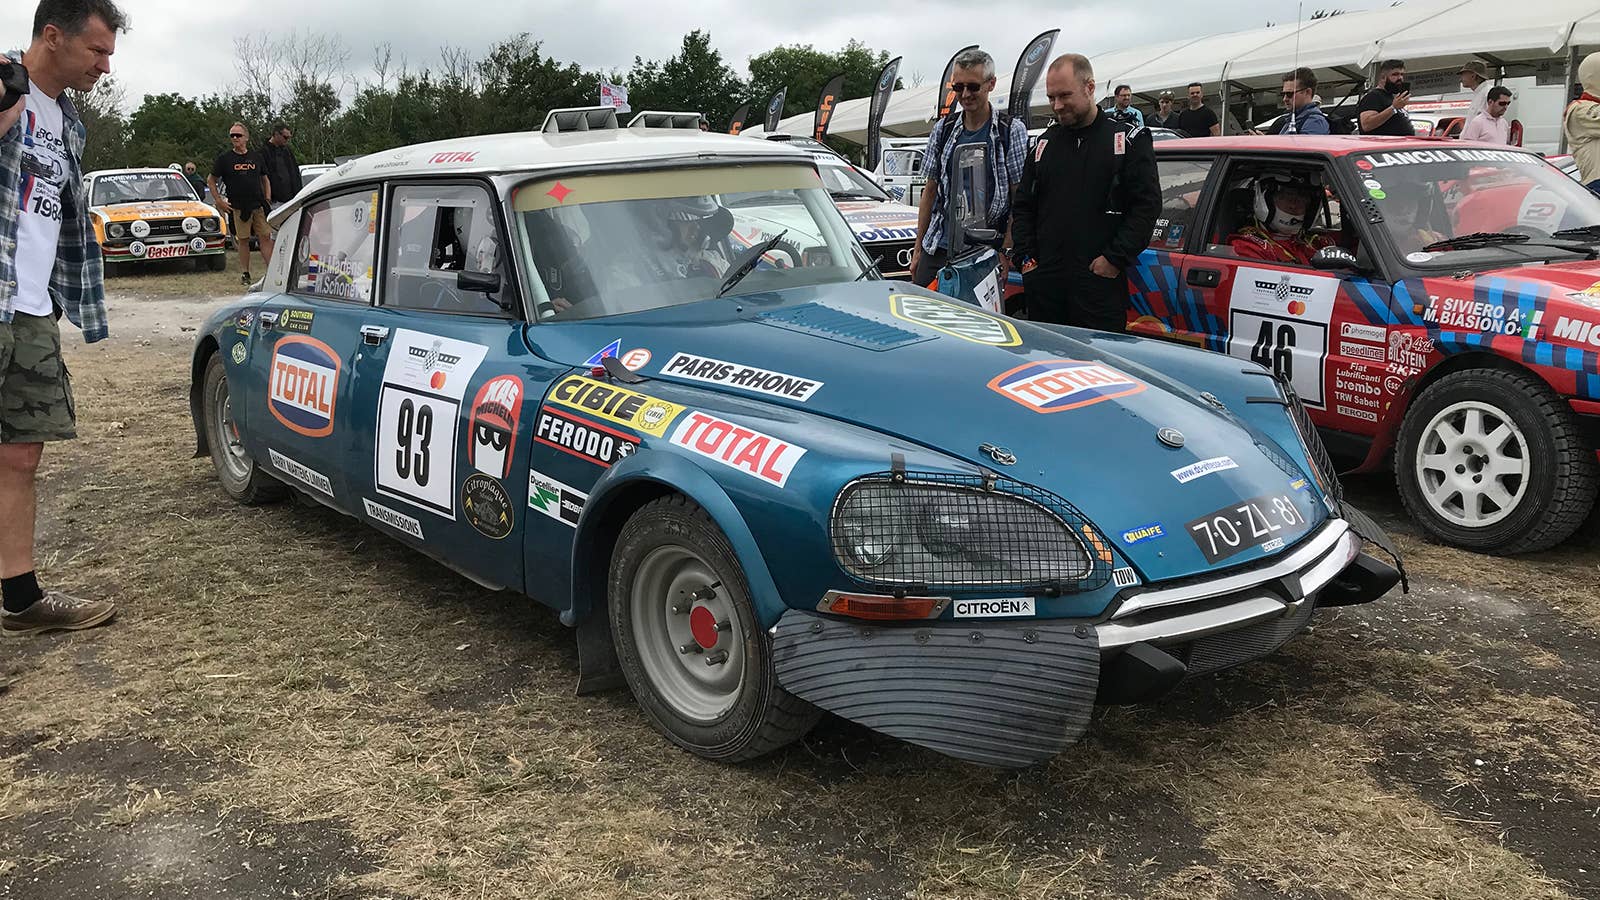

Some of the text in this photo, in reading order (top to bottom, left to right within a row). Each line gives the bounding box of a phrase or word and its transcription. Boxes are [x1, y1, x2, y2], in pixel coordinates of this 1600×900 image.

[234, 162, 256, 171] GCN
[428, 151, 479, 164] TOTAL
[1364, 149, 1538, 168] LANCIA MARTINI
[100, 174, 138, 184] ANDREWS
[354, 207, 364, 223] 93
[148, 244, 189, 259] Castrol
[1320, 246, 1357, 263] Valeo
[290, 310, 314, 320] SOUTHERN
[1429, 295, 1526, 322] T. SIVIERO A+
[1504, 321, 1522, 335] O+
[1251, 320, 1296, 379] 46
[1341, 345, 1384, 361] speedline
[1388, 346, 1427, 368] BILSTEIN
[629, 351, 645, 367] E
[1350, 362, 1367, 372] Fiat
[667, 355, 815, 398] PARIS-RHONE
[1336, 368, 1381, 383] Lubrificanti
[1386, 362, 1421, 376] SKF
[276, 361, 330, 414] TOTAL
[1011, 368, 1131, 401] TOTAL
[1336, 377, 1382, 396] brembo
[1335, 391, 1353, 402] TRW
[475, 401, 515, 428] MICHELIN
[1339, 407, 1375, 420] FERODO
[396, 398, 433, 487] 93
[537, 415, 614, 462] FERODO
[681, 413, 790, 483] TOTAL
[530, 475, 560, 494] Ducellier
[466, 479, 508, 510] Citroplaque
[367, 503, 421, 536] TRANSMISSIONS
[1124, 525, 1163, 544] QUAIFE
[1114, 568, 1135, 586] TOW
[956, 600, 1020, 615] CITROËN
